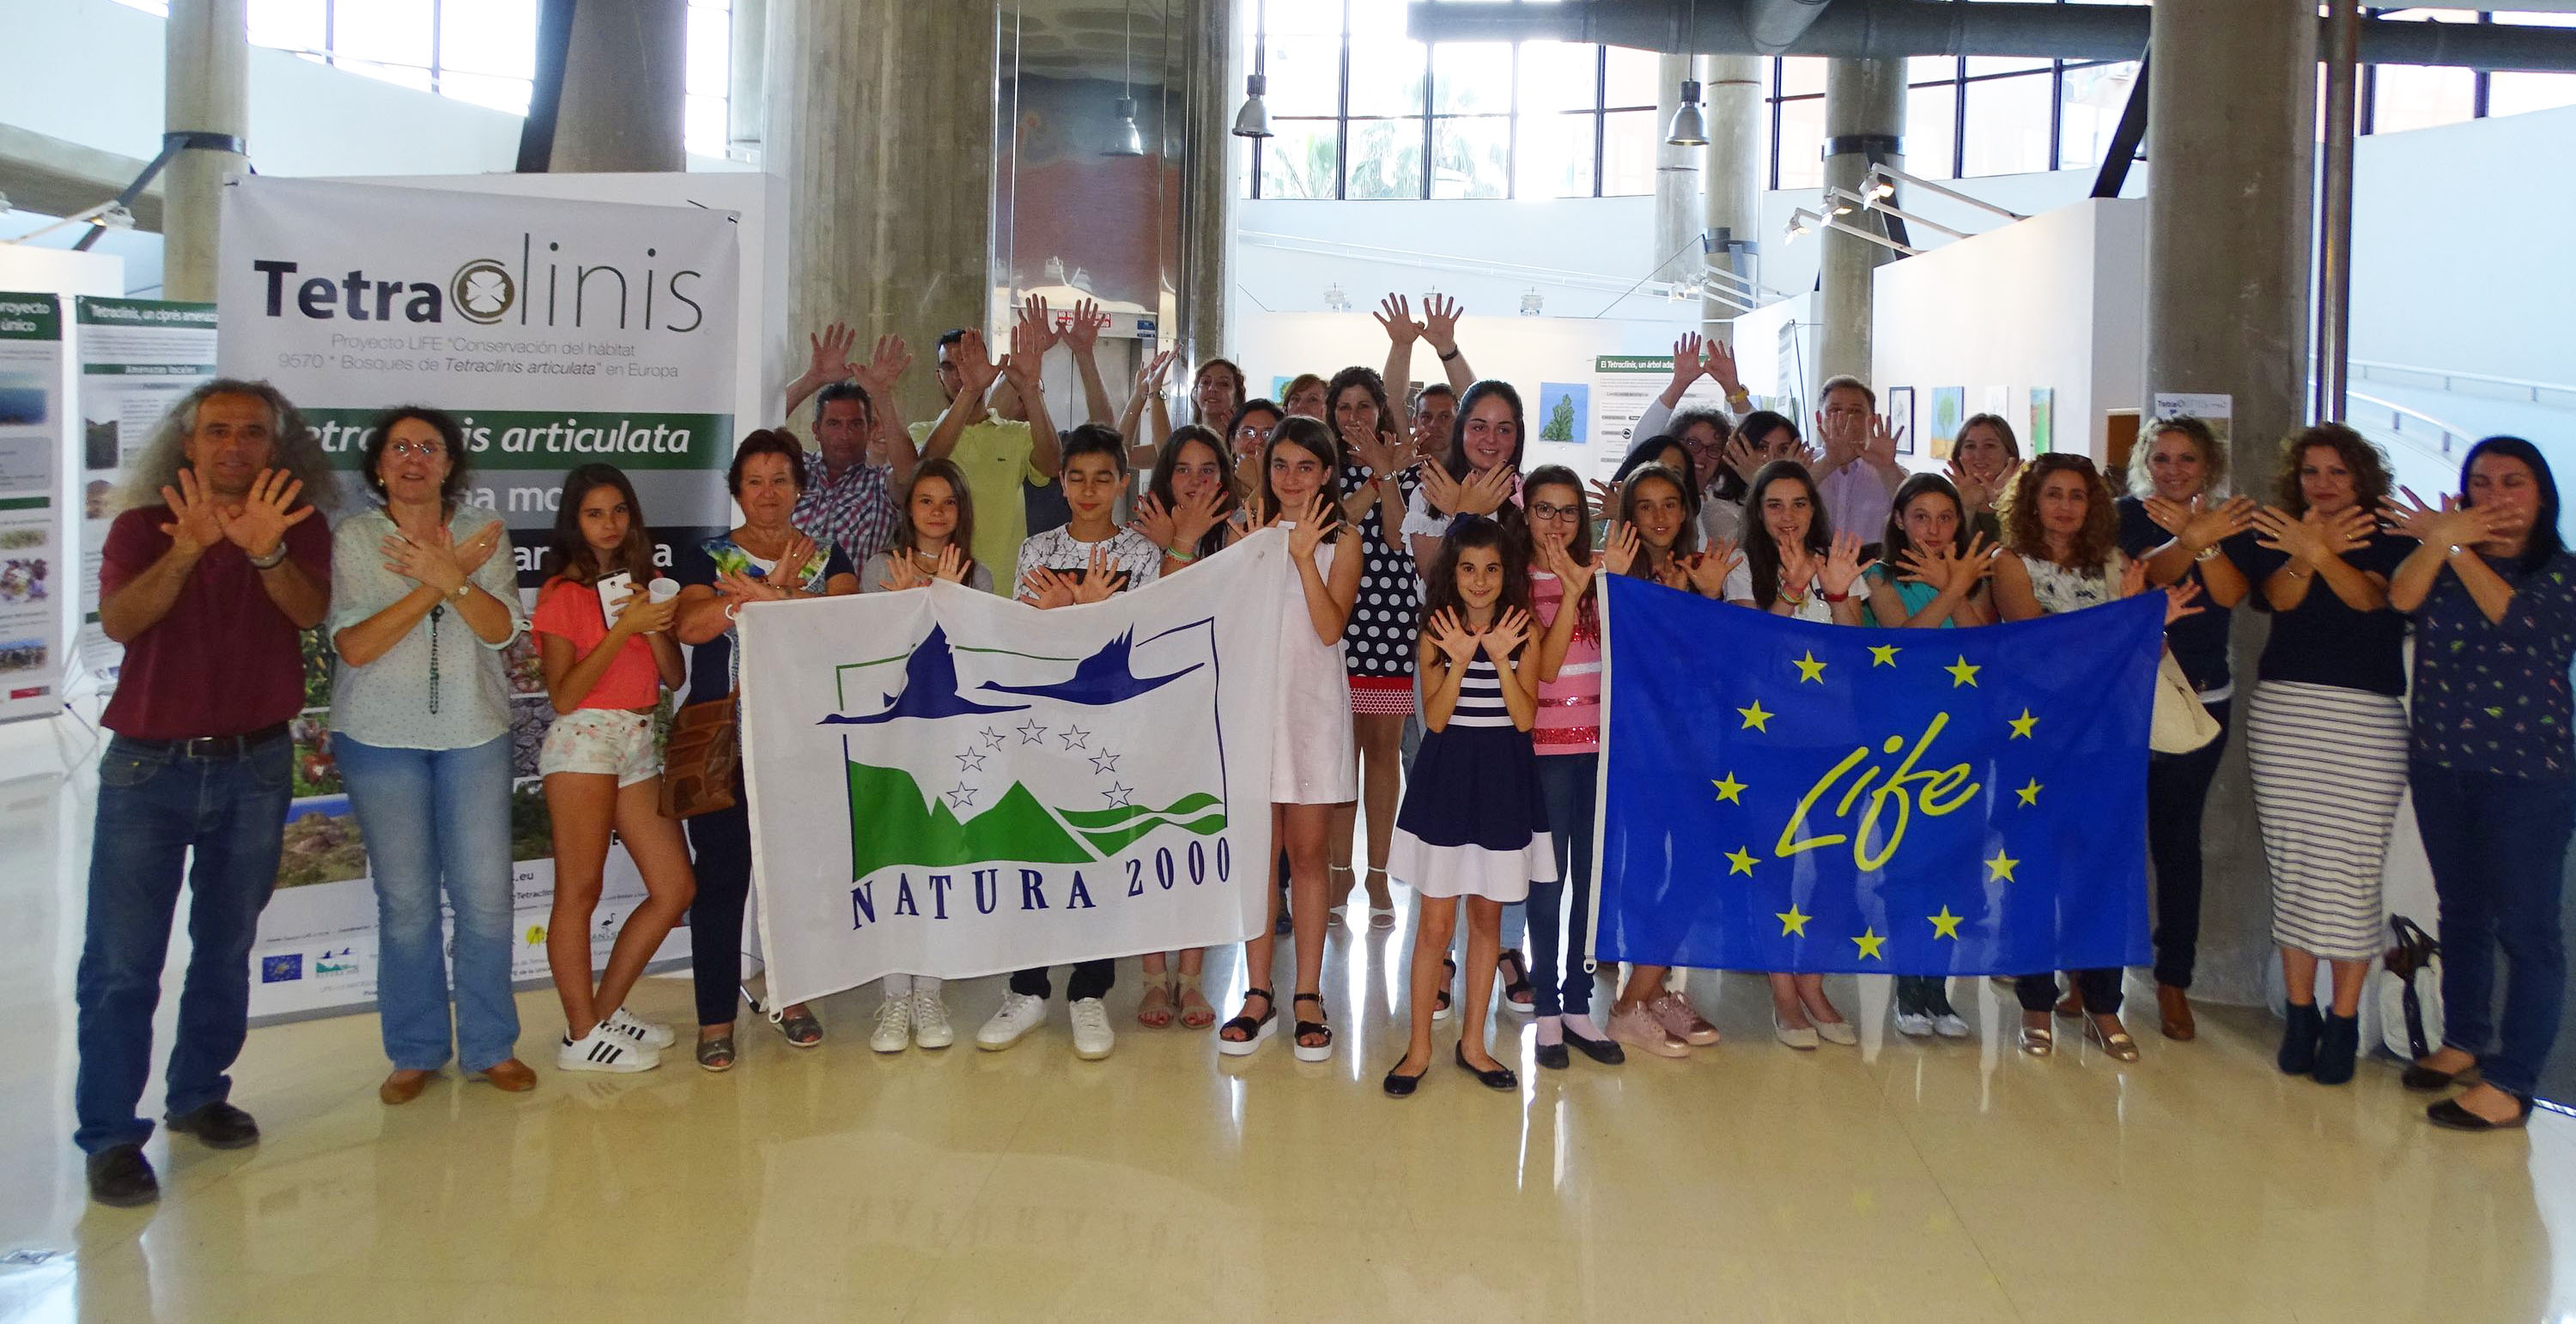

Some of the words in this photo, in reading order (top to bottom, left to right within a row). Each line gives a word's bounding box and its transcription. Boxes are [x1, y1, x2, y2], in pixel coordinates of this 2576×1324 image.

[0, 302, 50, 315] royecto
[331, 333, 404, 351] Proyecto
[408, 336, 443, 350] LIFE
[562, 342, 584, 355] del
[277, 353, 325, 368] 9570
[341, 354, 414, 371] Bosques
[418, 357, 439, 372] de
[445, 357, 523, 374] Tetraclinis
[605, 364, 624, 375] en
[628, 363, 679, 378] Europa
[501, 418, 691, 454] articulata
[1775, 712, 1980, 872] Life
[851, 868, 1097, 930] NATURA
[1125, 836, 1230, 897] 2000
